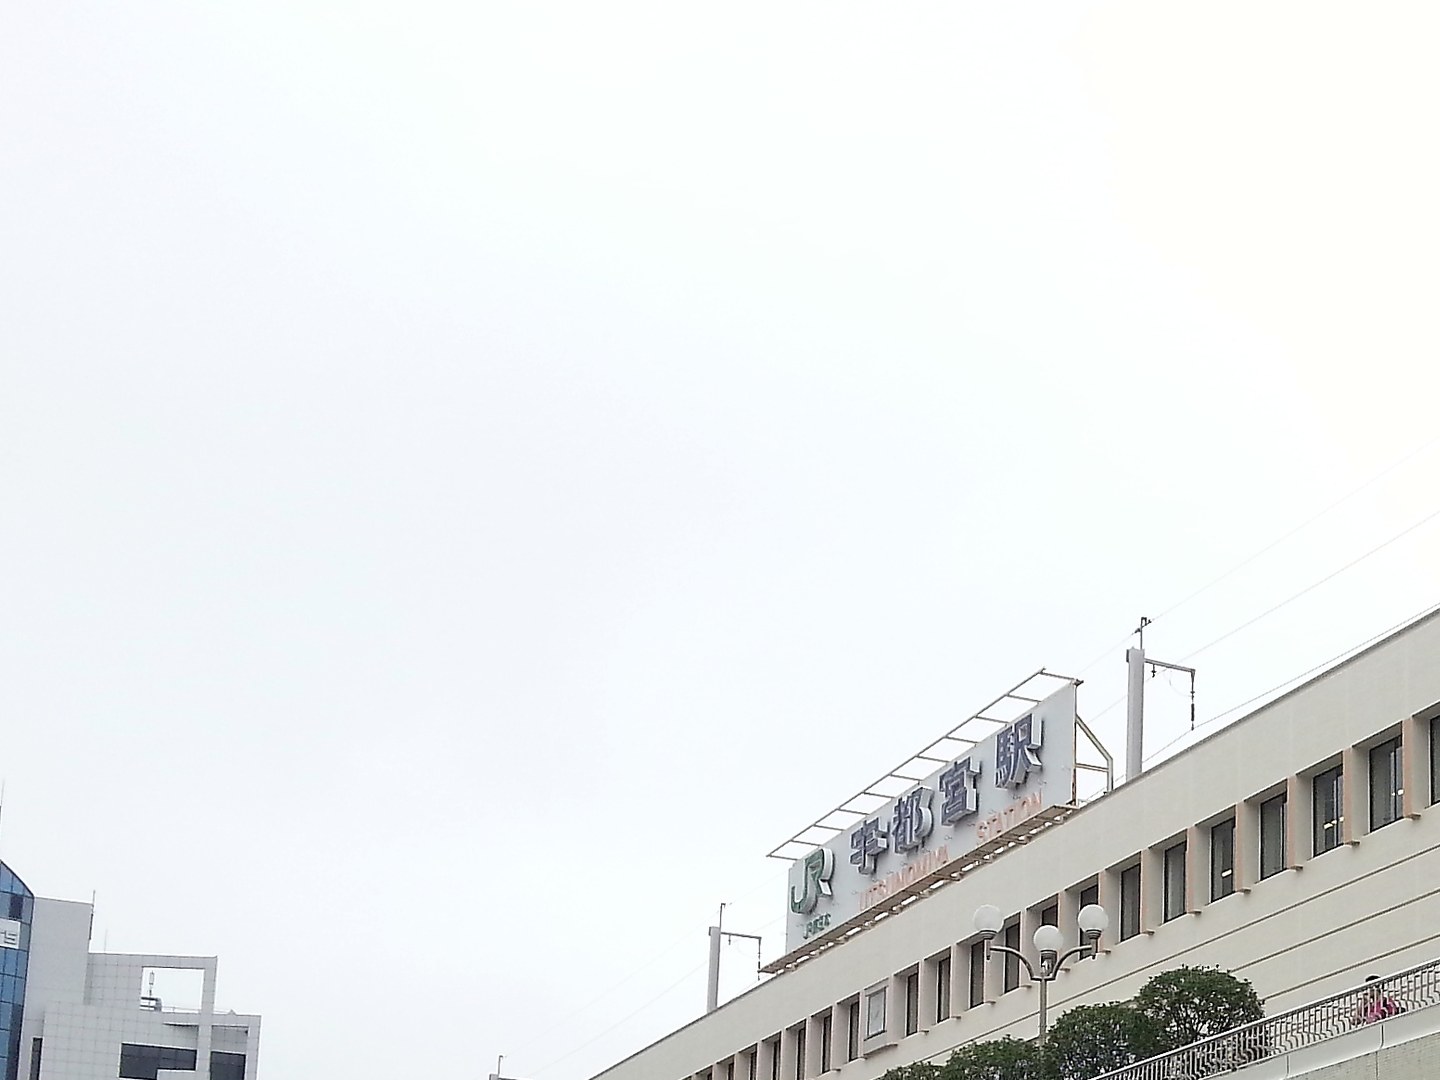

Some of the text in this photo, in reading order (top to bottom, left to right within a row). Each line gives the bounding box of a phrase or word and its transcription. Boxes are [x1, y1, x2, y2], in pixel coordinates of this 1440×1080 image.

[790, 713, 1043, 914] JR 宇都宮駅
